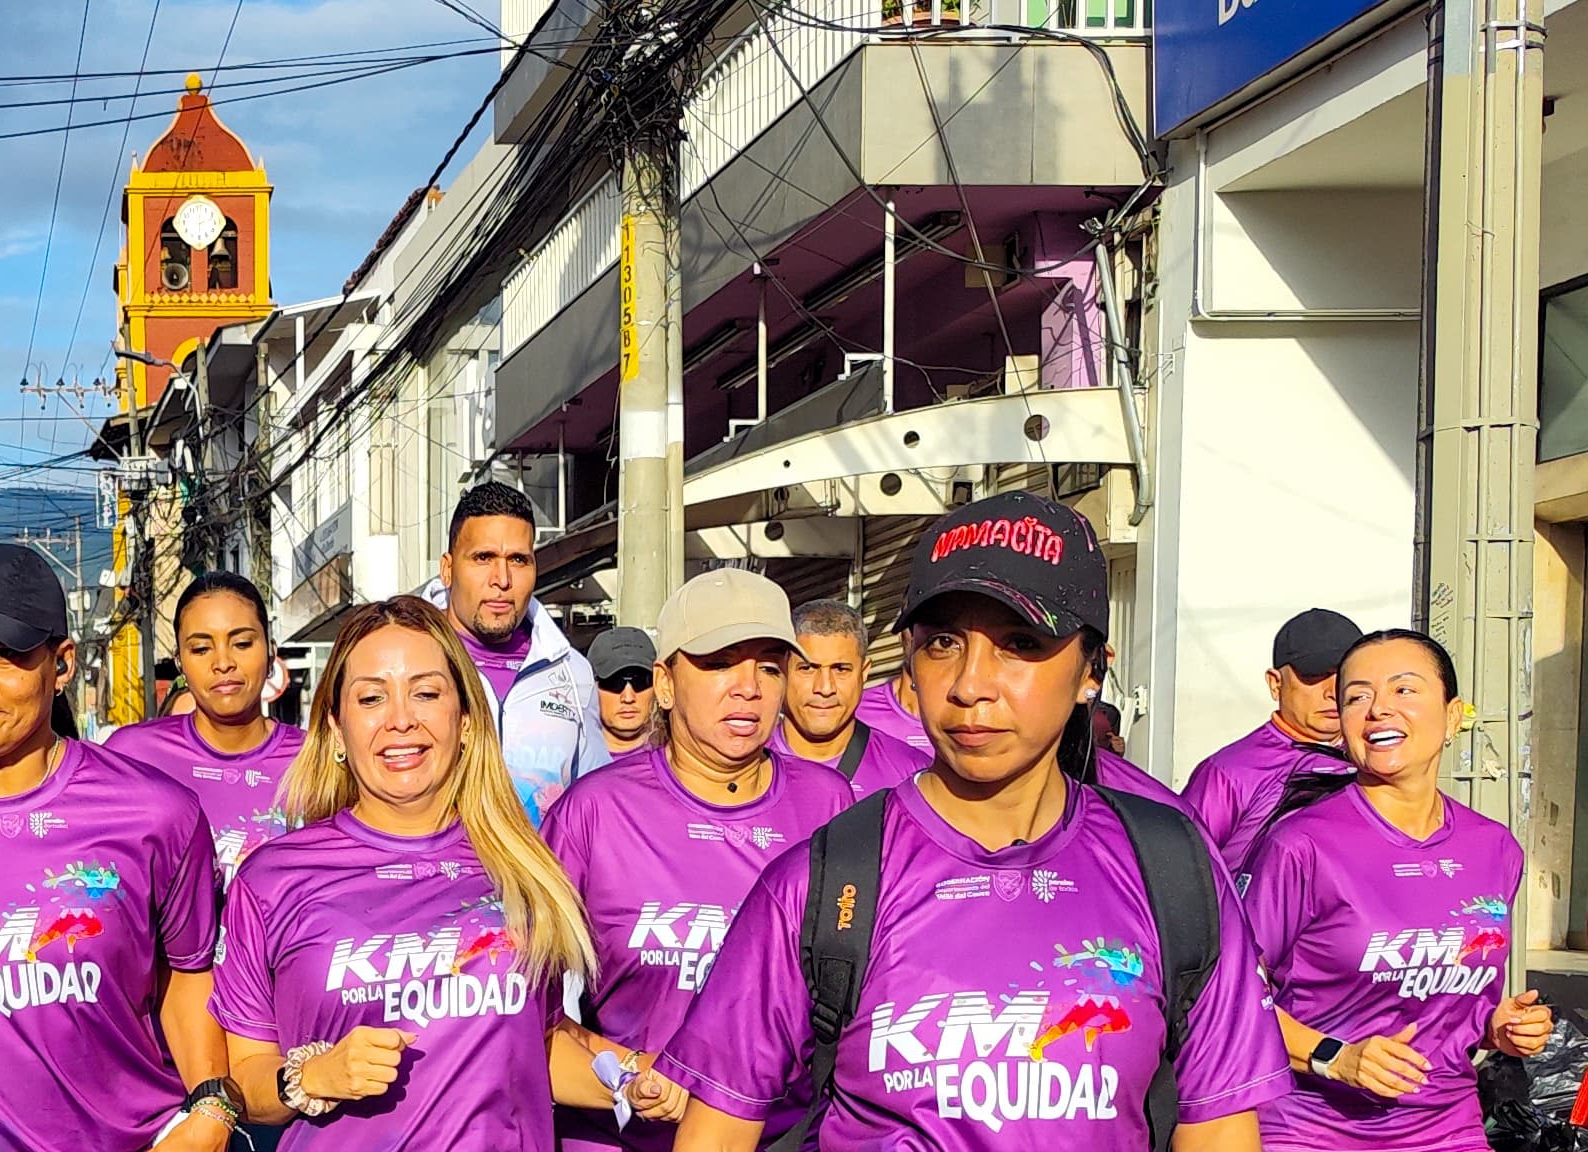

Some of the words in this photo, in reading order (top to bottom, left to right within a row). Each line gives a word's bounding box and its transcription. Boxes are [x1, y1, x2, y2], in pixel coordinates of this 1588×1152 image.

[326, 927, 462, 992] KM
[640, 949, 663, 966] POR
[664, 951, 680, 966] LA
[1358, 926, 1465, 973] KM
[341, 987, 367, 1006] POR
[367, 984, 384, 1004] LA
[383, 972, 527, 1028] EQUIDAD
[868, 990, 1051, 1073] KM
[882, 1069, 914, 1094] POR
[914, 1063, 934, 1088] LA
[934, 1061, 1118, 1133] EQUIDAD
